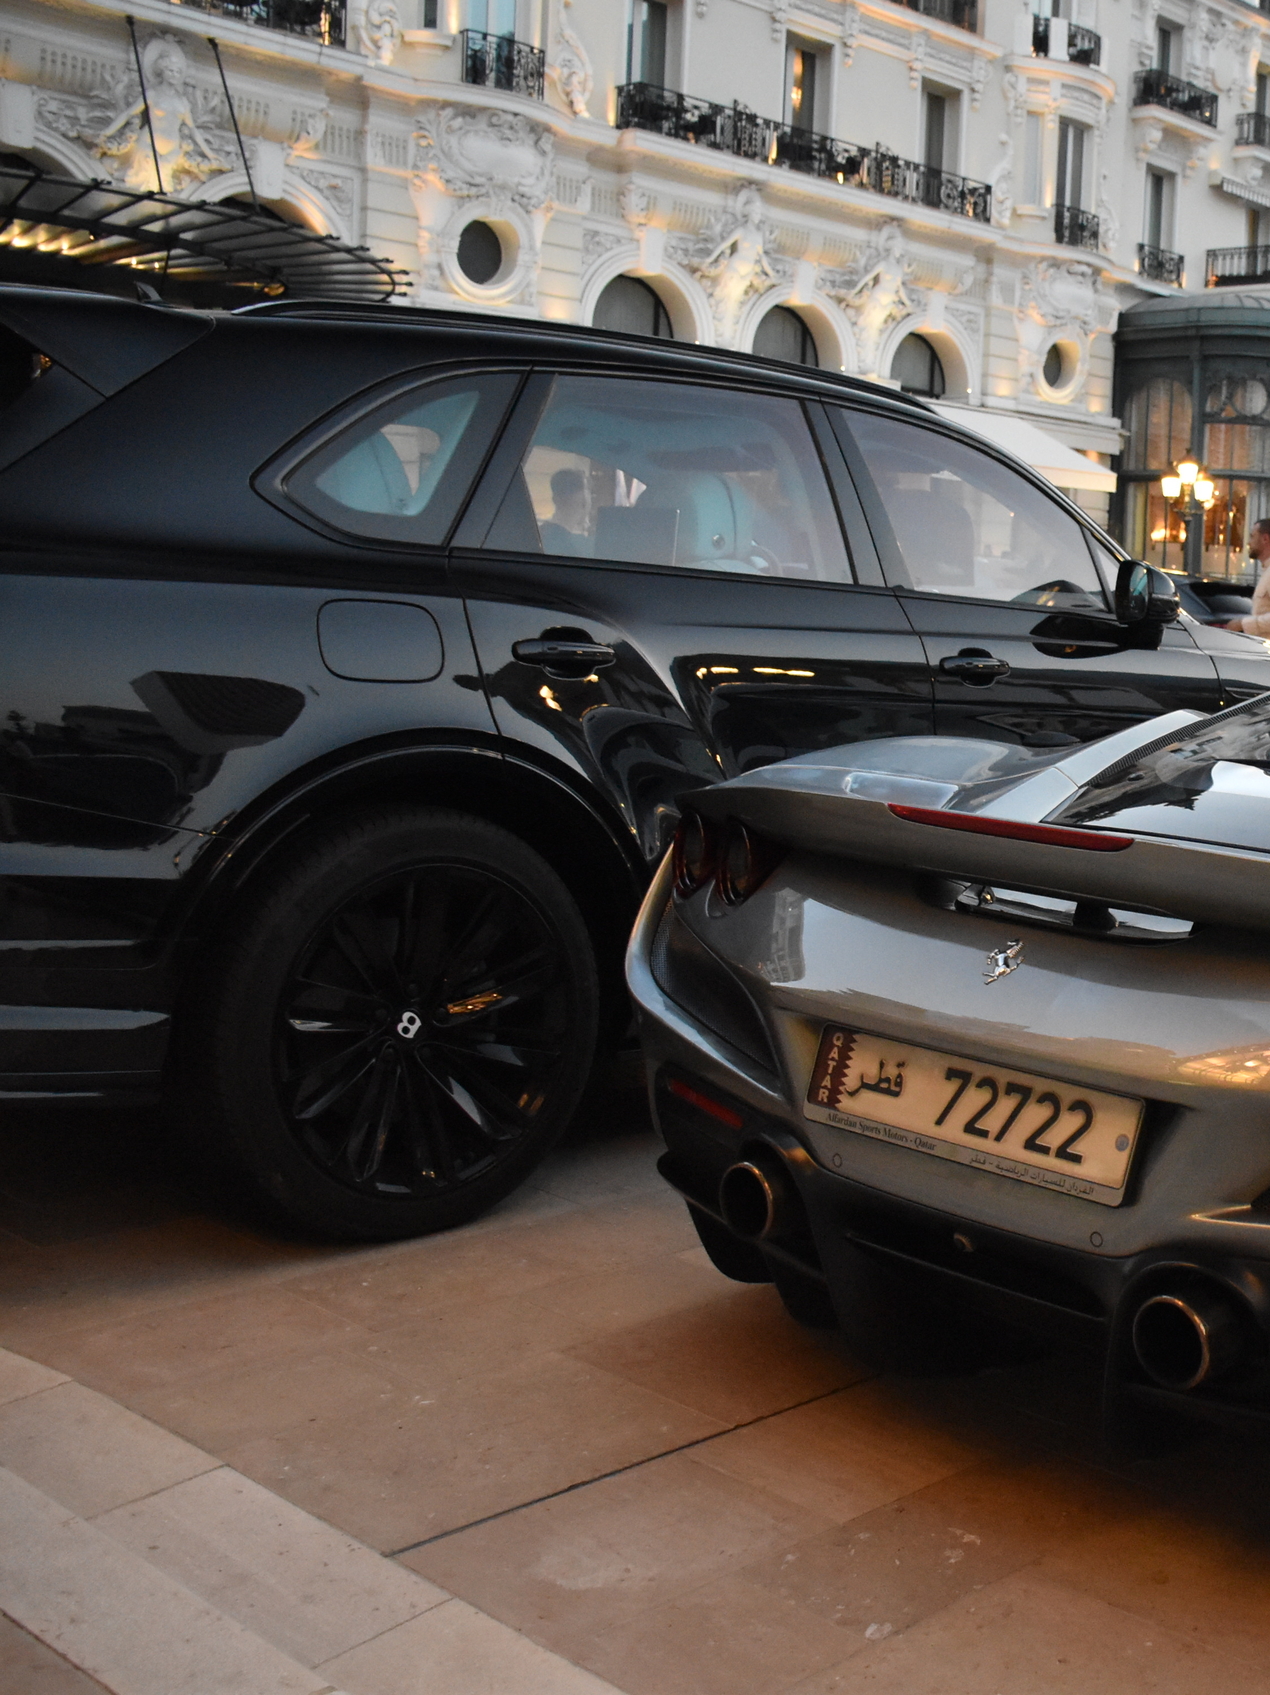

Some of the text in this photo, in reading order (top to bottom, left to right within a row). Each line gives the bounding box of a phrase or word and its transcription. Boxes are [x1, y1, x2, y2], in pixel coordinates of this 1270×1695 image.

[818, 1032, 844, 1102] QATAR
[844, 1059, 905, 1097] قطر
[827, 1112, 857, 1129] Alfardan
[860, 1121, 881, 1134] Sports
[883, 1127, 908, 1142] Motors
[914, 1137, 937, 1151] Qatar
[935, 1067, 1095, 1164] 72722
